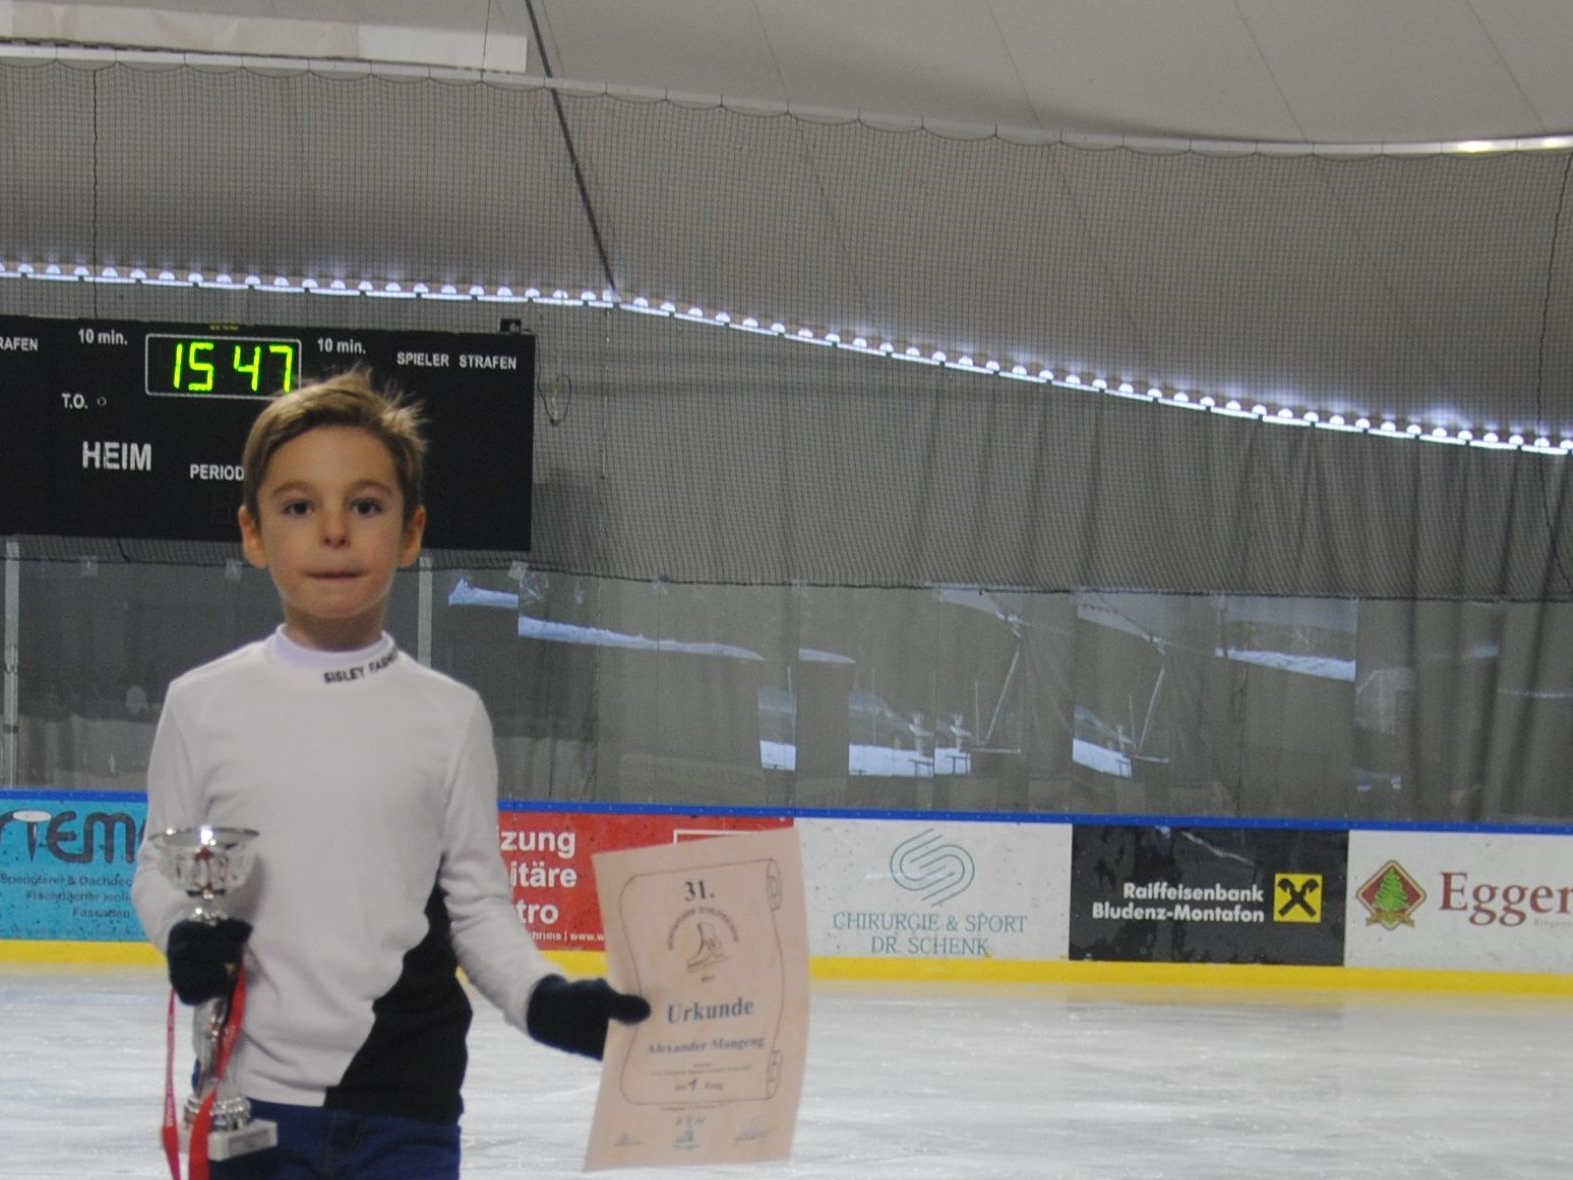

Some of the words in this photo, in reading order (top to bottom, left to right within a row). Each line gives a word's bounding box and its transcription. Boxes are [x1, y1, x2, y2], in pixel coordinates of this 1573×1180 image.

[78, 328, 94, 344] 10
[97, 329, 128, 346] min.
[317, 337, 333, 353] 10
[336, 338, 366, 355] min.
[173, 341, 215, 393] 15
[397, 351, 450, 368] SPIELER
[459, 353, 517, 371] STRAFEN
[61, 392, 89, 410] T.O.
[81, 440, 153, 472] HEIM
[500, 831, 576, 859] zung
[684, 880, 715, 902] 31.
[1123, 881, 1264, 902] Raiffeisenbank
[833, 912, 940, 931] CHIRURGIE
[945, 915, 959, 931] &
[964, 914, 1028, 933] SPORT
[1092, 901, 1265, 923] Bludenz-Montafon
[908, 936, 991, 957] SCHENK
[667, 998, 754, 1024] Urkunde
